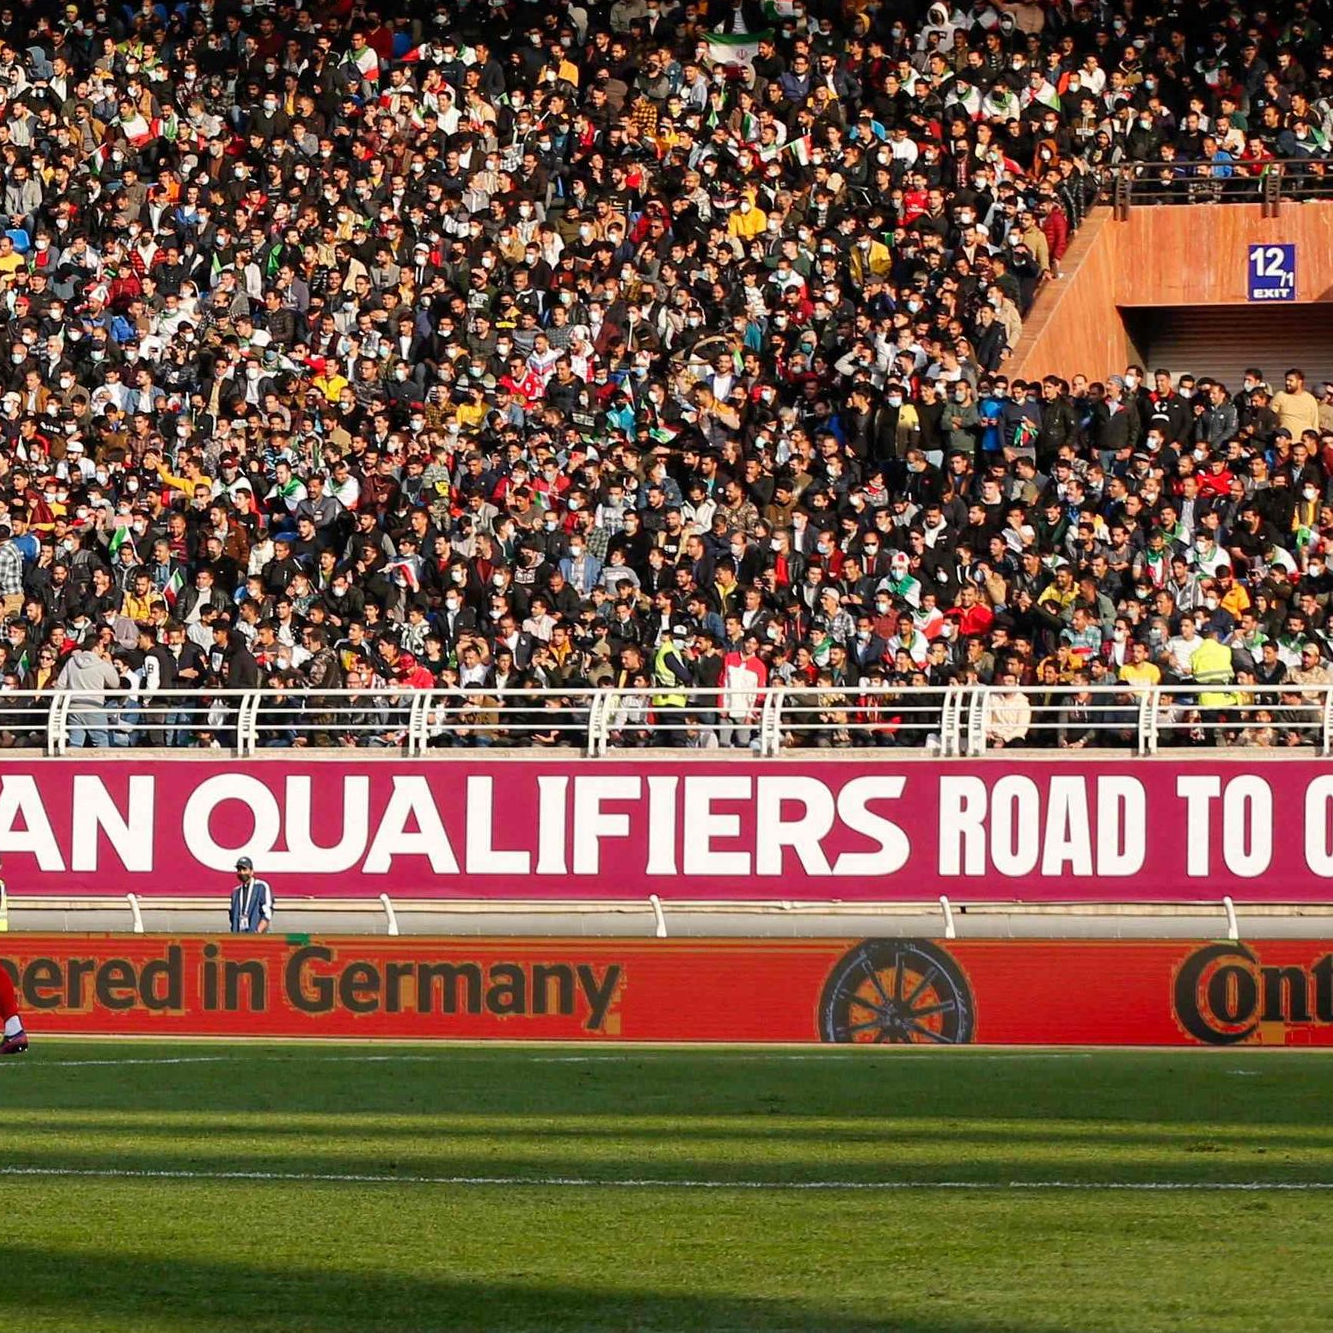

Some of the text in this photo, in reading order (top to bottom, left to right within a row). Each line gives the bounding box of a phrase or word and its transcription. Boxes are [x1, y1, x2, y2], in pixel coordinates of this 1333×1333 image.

[1253, 288, 1290, 298] EXIT
[182, 772, 911, 875] QUALIFIERS
[939, 775, 1146, 877] ROAD
[1177, 774, 1273, 877] TO
[204, 943, 265, 1012] in
[285, 946, 621, 1030] Germany
[1174, 943, 1333, 1044] Cont
